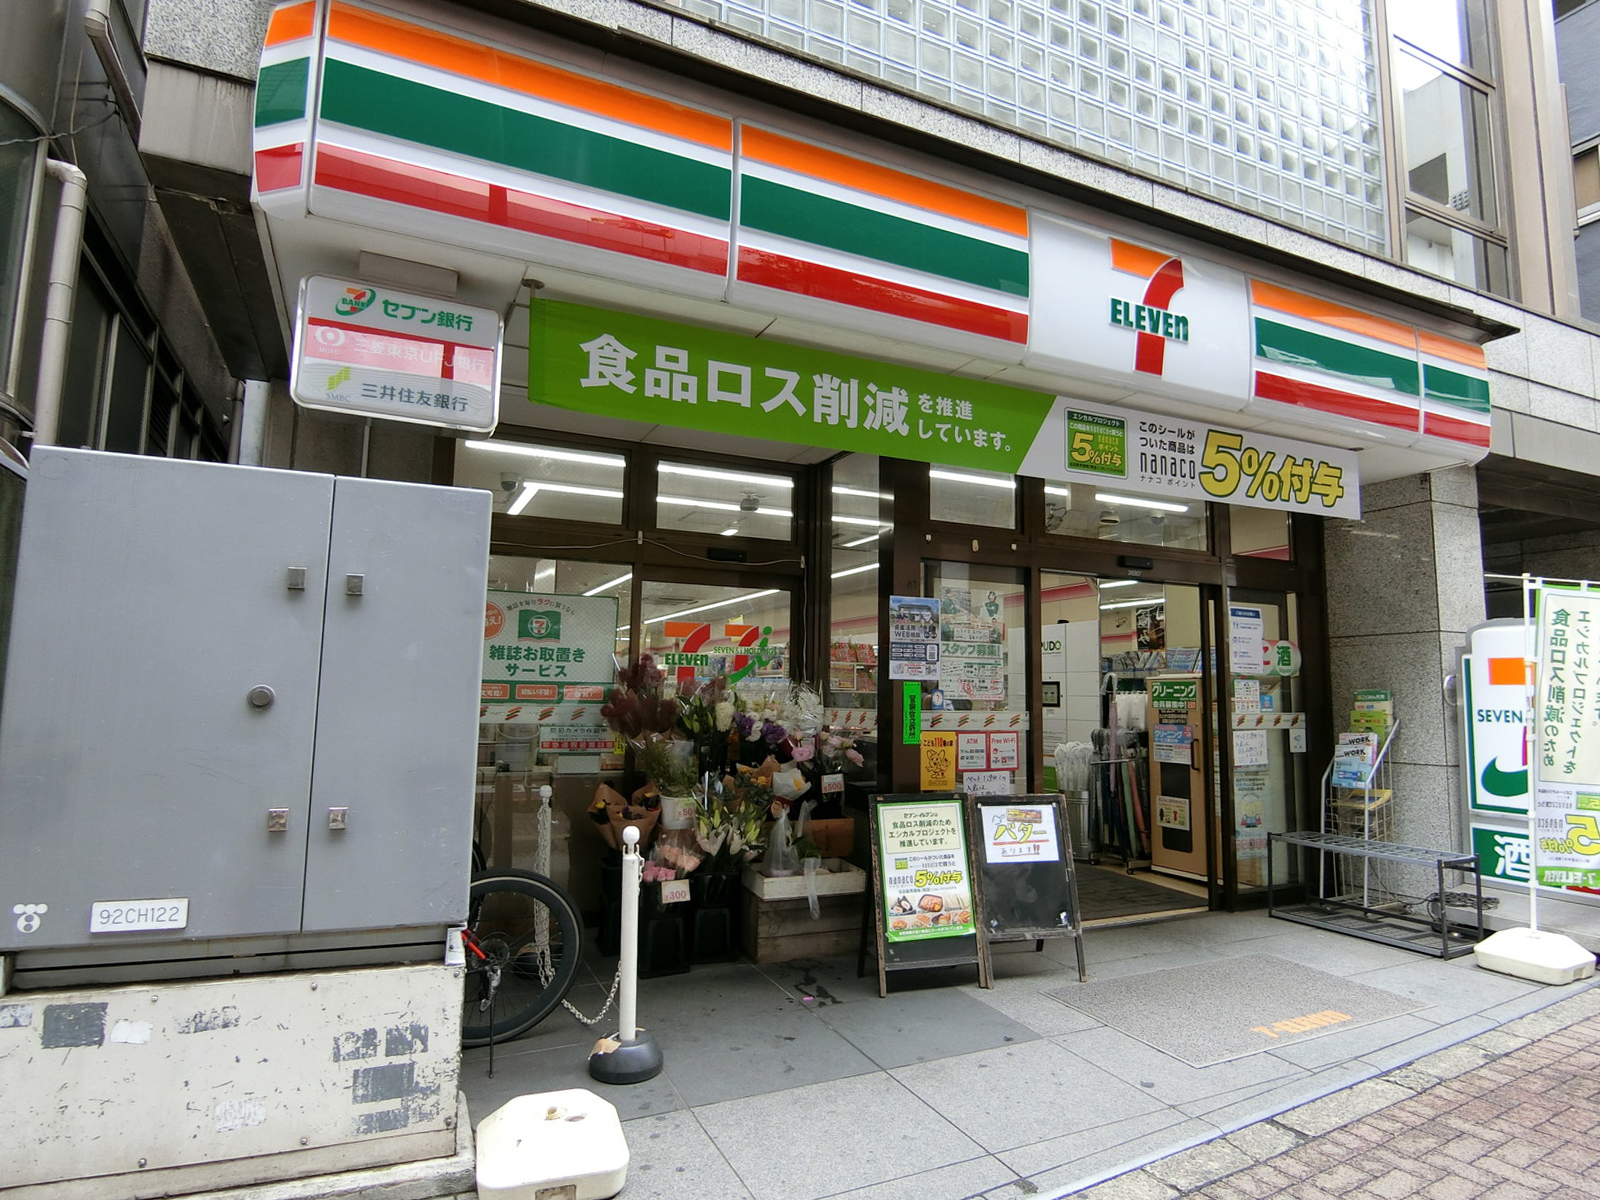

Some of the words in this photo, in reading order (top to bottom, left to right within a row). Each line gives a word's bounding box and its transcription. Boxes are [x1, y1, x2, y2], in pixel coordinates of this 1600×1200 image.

[341, 297, 367, 309] BANK
[383, 298, 473, 332] セブン銀行
[353, 336, 486, 372] 三菱東京UFJ銀行
[578, 333, 909, 437] 食品ロス削減
[325, 393, 352, 404] SMBC
[361, 382, 469, 412] 三井住友銀行
[917, 392, 973, 421] を推進
[1072, 413, 1121, 429] エシカルプロジェクト
[917, 419, 1012, 453] しています。
[1138, 420, 1196, 441] このシールが
[1070, 431, 1122, 467] 5%付与
[1139, 436, 1196, 456] ついた商品は
[1139, 452, 1196, 480] nanaco
[1199, 428, 1344, 508] 5%付与
[1139, 475, 1162, 485] ナナコ
[1167, 478, 1196, 489] ポイント
[489, 644, 586, 663] 雑誌お取置き
[713, 646, 734, 655] SEVEN
[942, 643, 1001, 657] スタッフ募集!
[1041, 640, 1062, 652] UDO
[1276, 645, 1291, 667] 酒
[505, 663, 568, 678] サービス
[1152, 684, 1197, 697] クリーニング
[1477, 708, 1523, 723] SEVEN
[1154, 729, 1182, 739] クリーニング
[1348, 735, 1371, 745] WORK
[1343, 748, 1366, 757] WORK
[888, 827, 957, 838] エシカルプロジェクトを
[892, 819, 952, 829] 食品ロス削減のため
[994, 822, 1047, 844] バター
[899, 837, 948, 848] 推進しています。
[1493, 833, 1532, 884] 酒
[888, 875, 914, 885] nanaco
[914, 869, 963, 888] 5%付与
[99, 905, 180, 925] 92CH122
